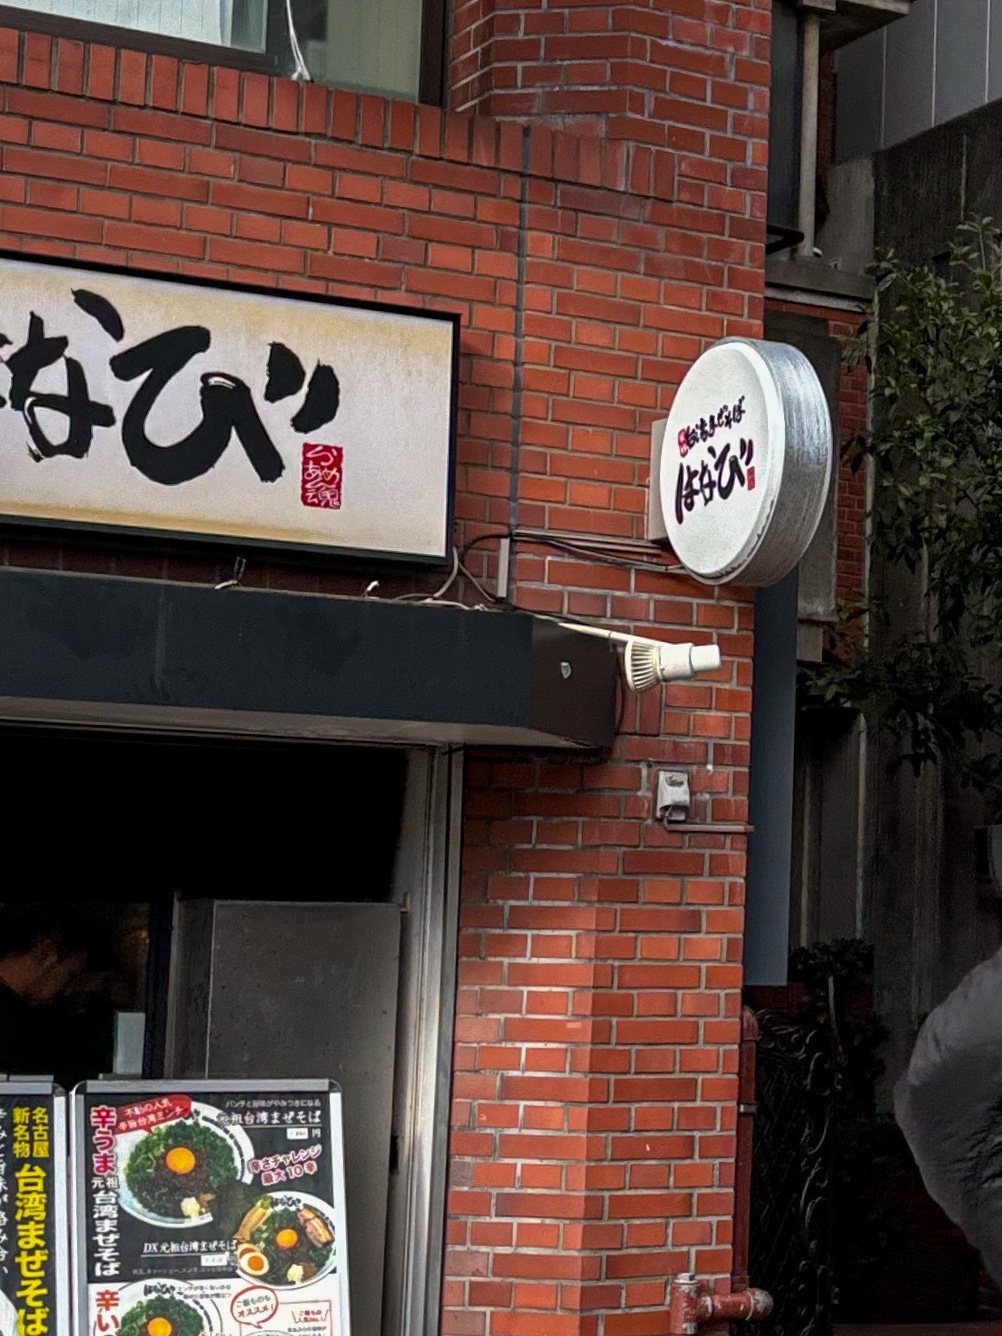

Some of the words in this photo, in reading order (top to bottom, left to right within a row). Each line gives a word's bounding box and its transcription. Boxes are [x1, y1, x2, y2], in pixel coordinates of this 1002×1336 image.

[0, 288, 340, 485] なび
[675, 438, 754, 525] はなび
[13, 1107, 30, 1159] 新名物
[32, 1107, 50, 1159] 名古屋
[90, 1106, 117, 1176] 辛うま
[92, 1190, 121, 1277] 台湾まぜそば
